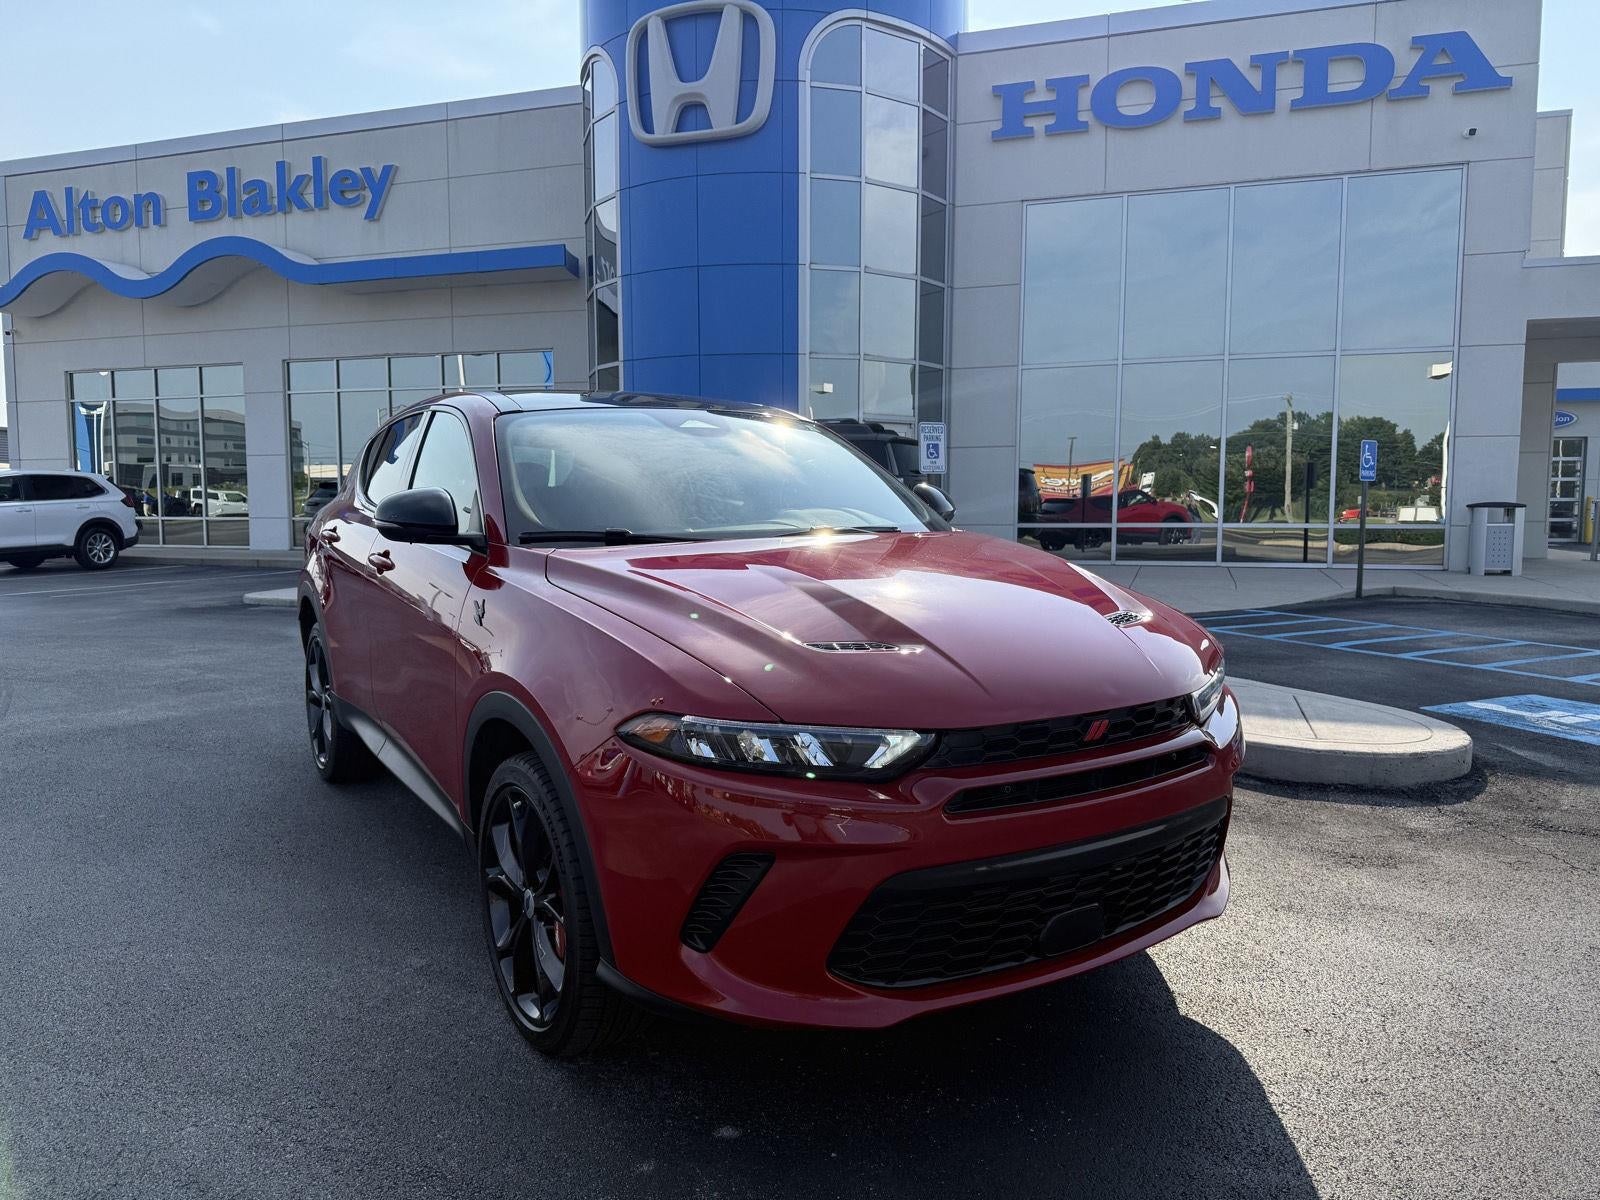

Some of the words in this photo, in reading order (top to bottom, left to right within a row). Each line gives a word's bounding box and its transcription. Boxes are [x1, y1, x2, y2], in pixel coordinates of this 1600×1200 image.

[991, 31, 1514, 140] HONDA
[23, 187, 165, 240] Alton
[186, 156, 397, 221] Blakley
[921, 425, 944, 434] RESERVED
[923, 434, 942, 442] PARKING
[1361, 469, 1375, 477] PARKING
